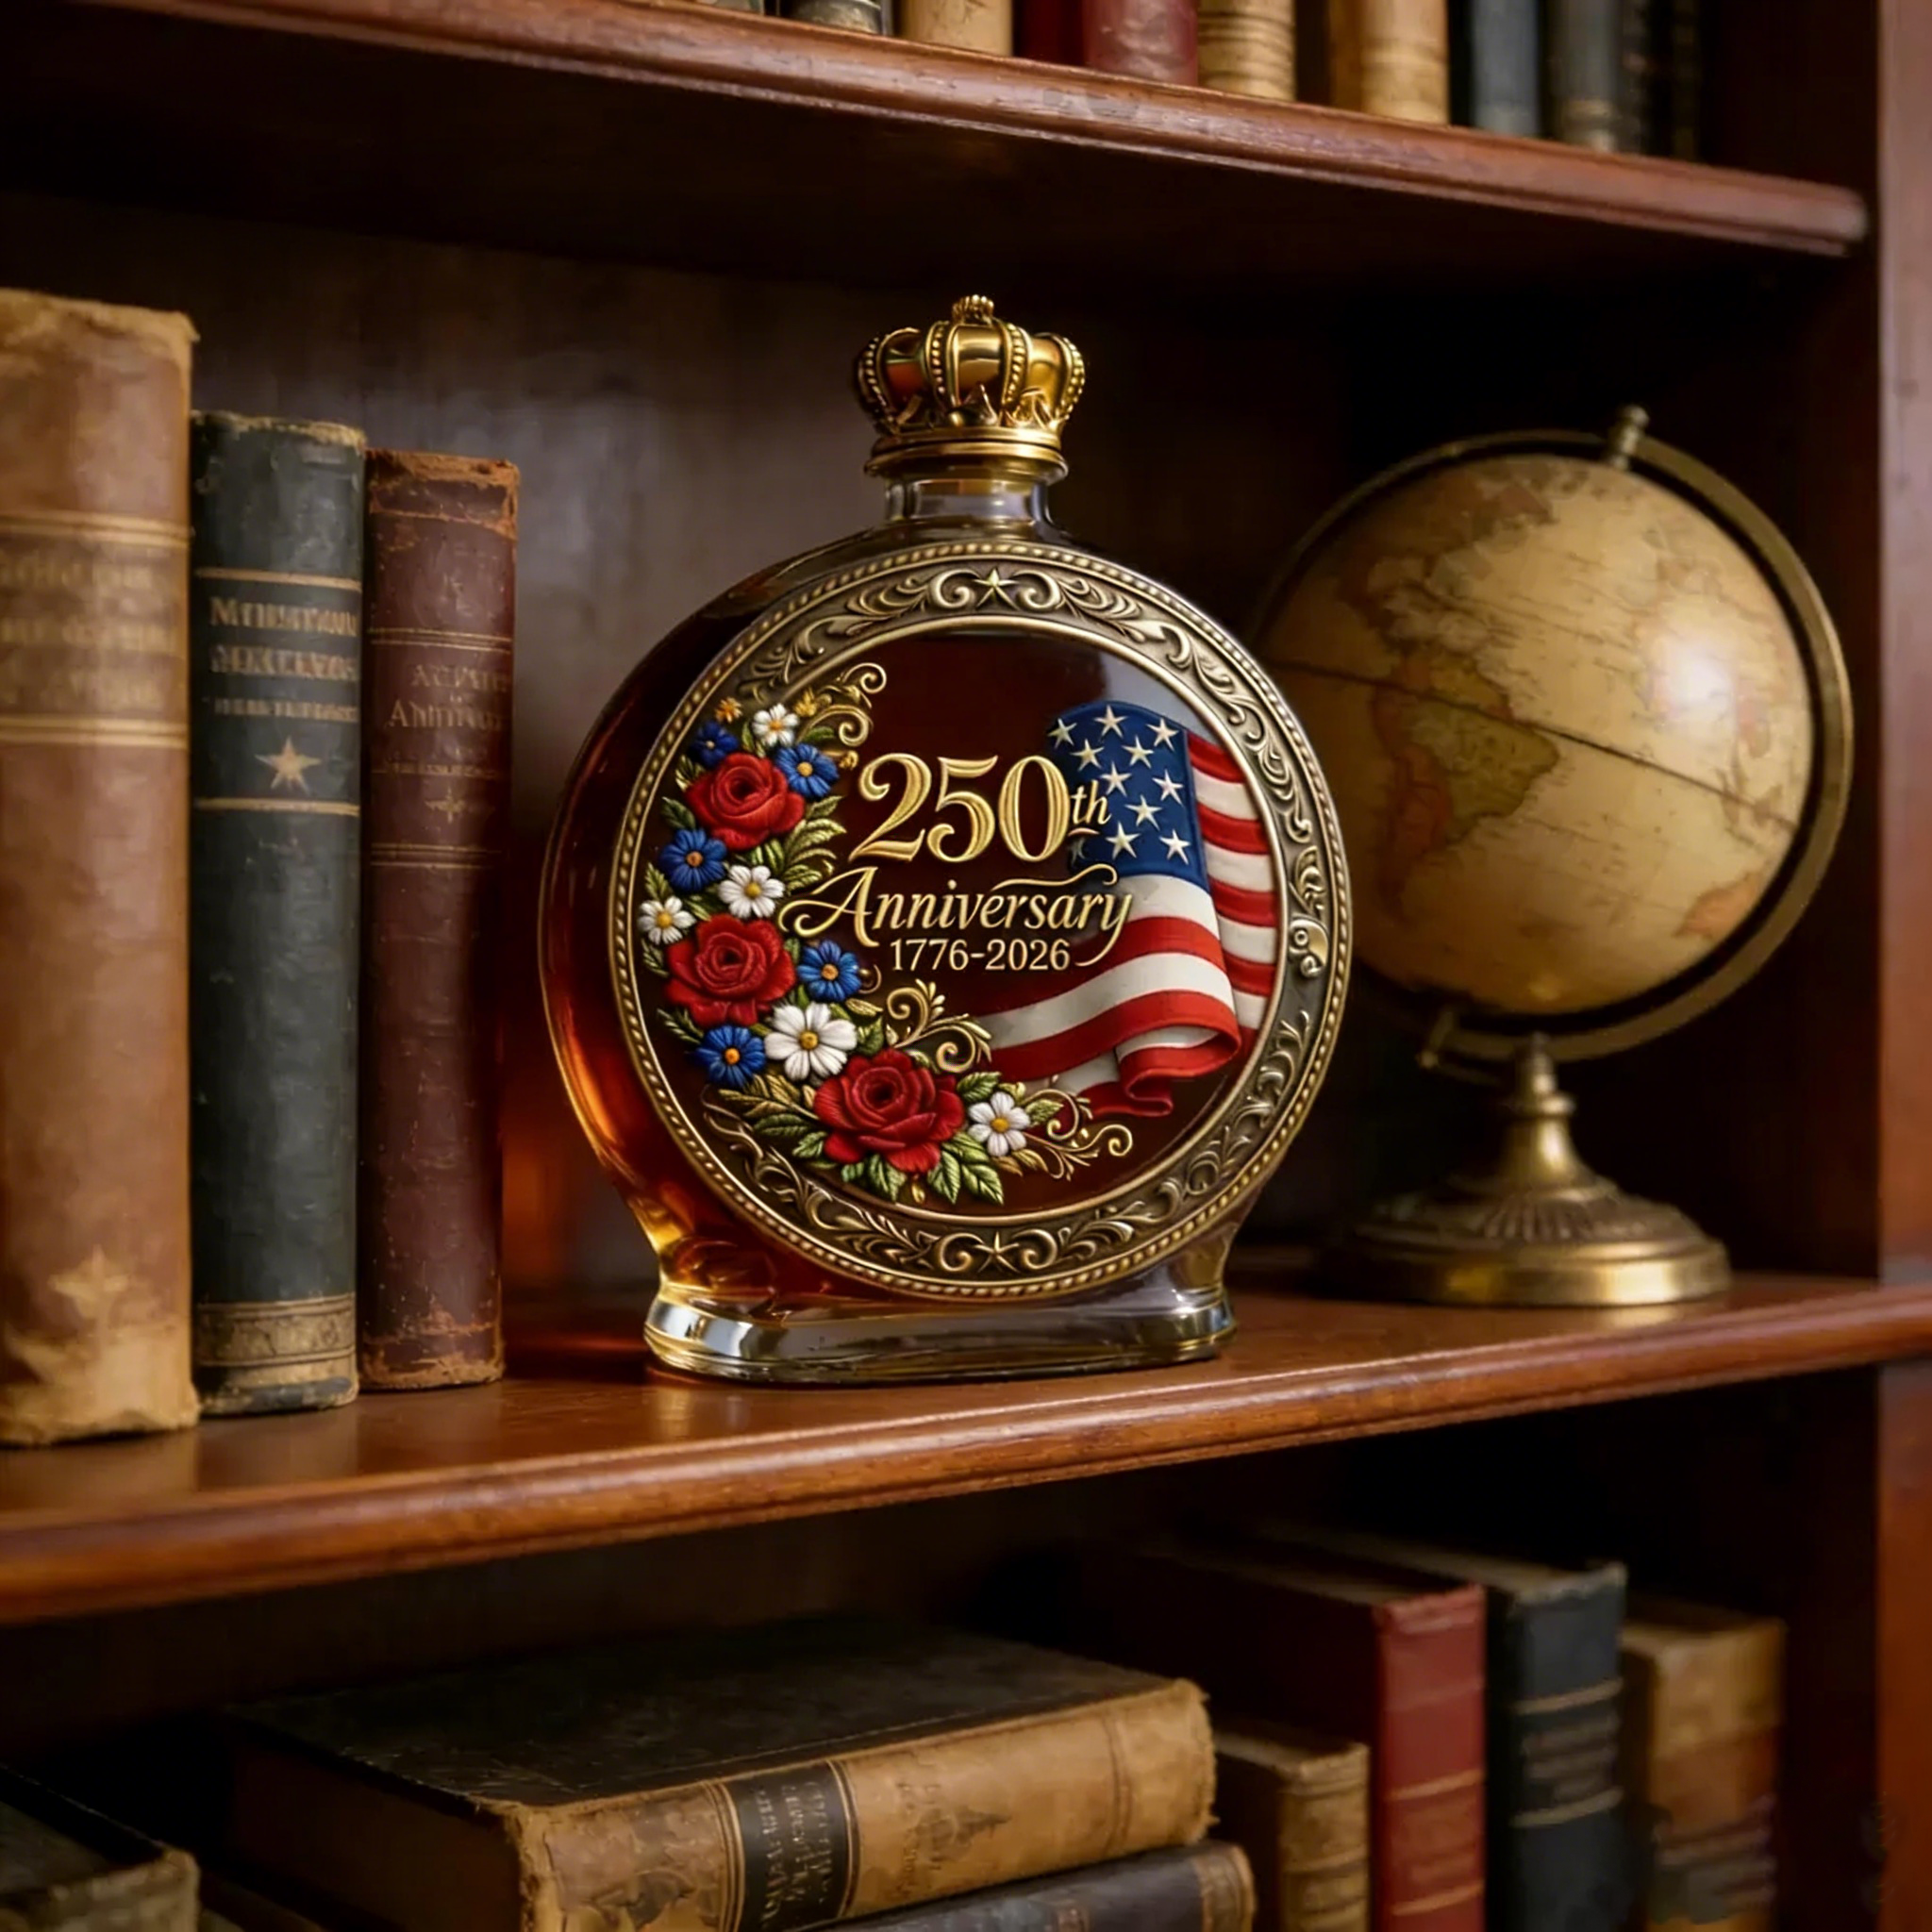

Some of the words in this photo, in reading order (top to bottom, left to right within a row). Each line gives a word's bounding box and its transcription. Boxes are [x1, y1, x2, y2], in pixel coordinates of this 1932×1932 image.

[849, 752, 1111, 862] 250th
[778, 864, 1133, 967] Anniversary
[890, 938, 1071, 971] 1776-2026
